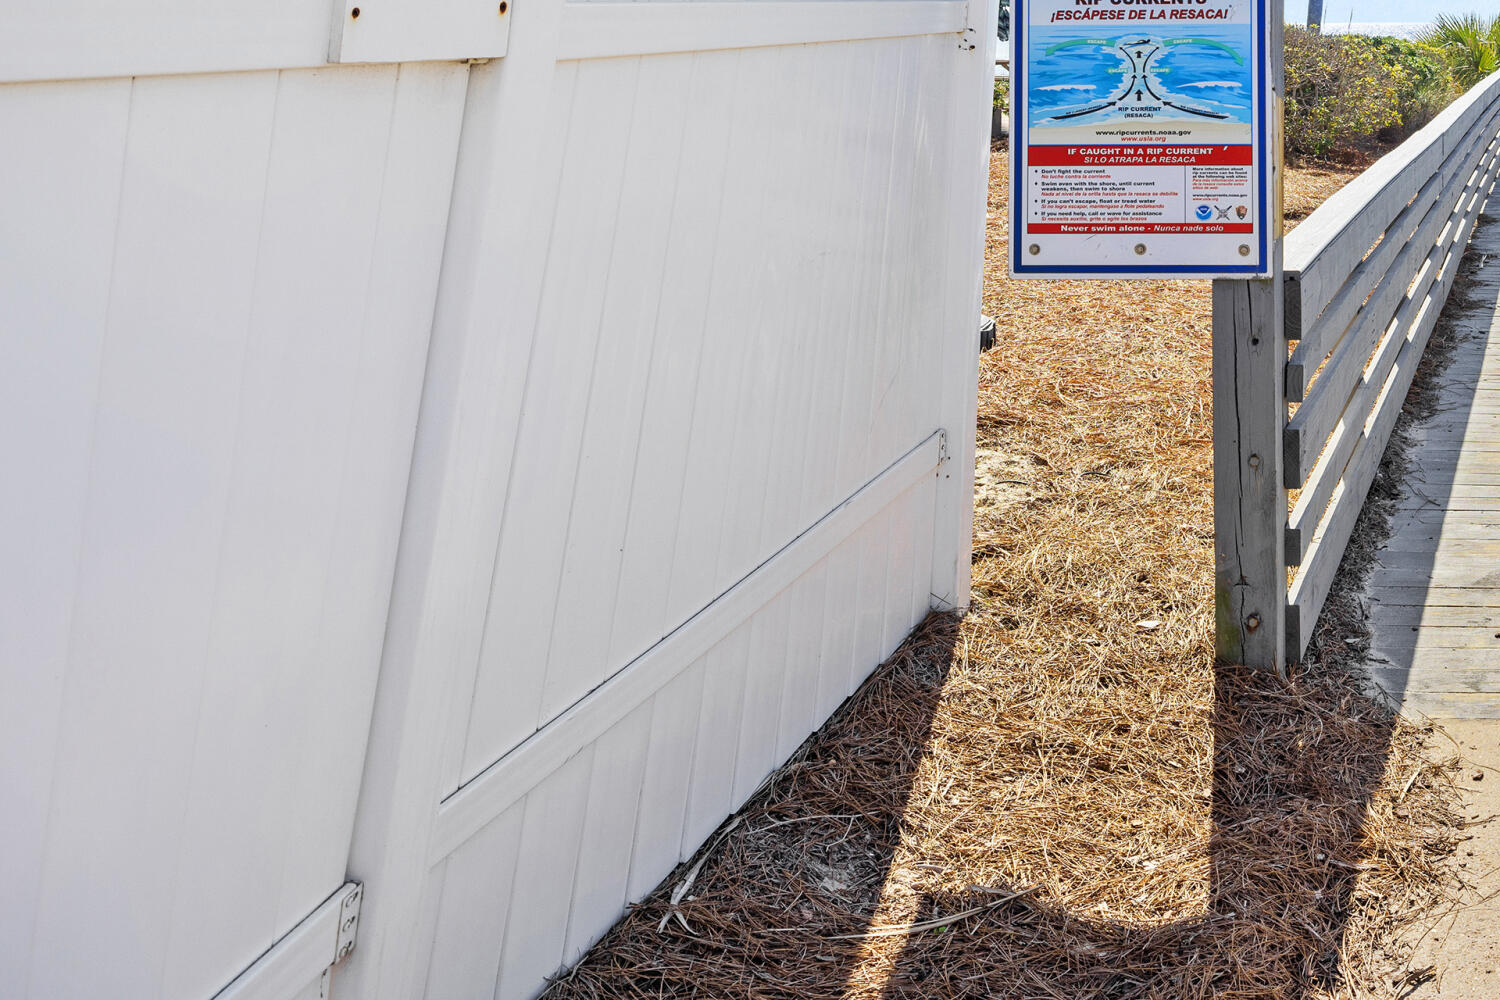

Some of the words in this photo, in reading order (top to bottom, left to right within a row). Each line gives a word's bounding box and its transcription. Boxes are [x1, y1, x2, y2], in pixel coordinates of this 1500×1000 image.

[1051, 8, 1125, 23] ¡ESCÁPESE
[1128, 10, 1147, 20] DE
[1151, 10, 1168, 19] LA
[1170, 9, 1227, 19] RESACA!
